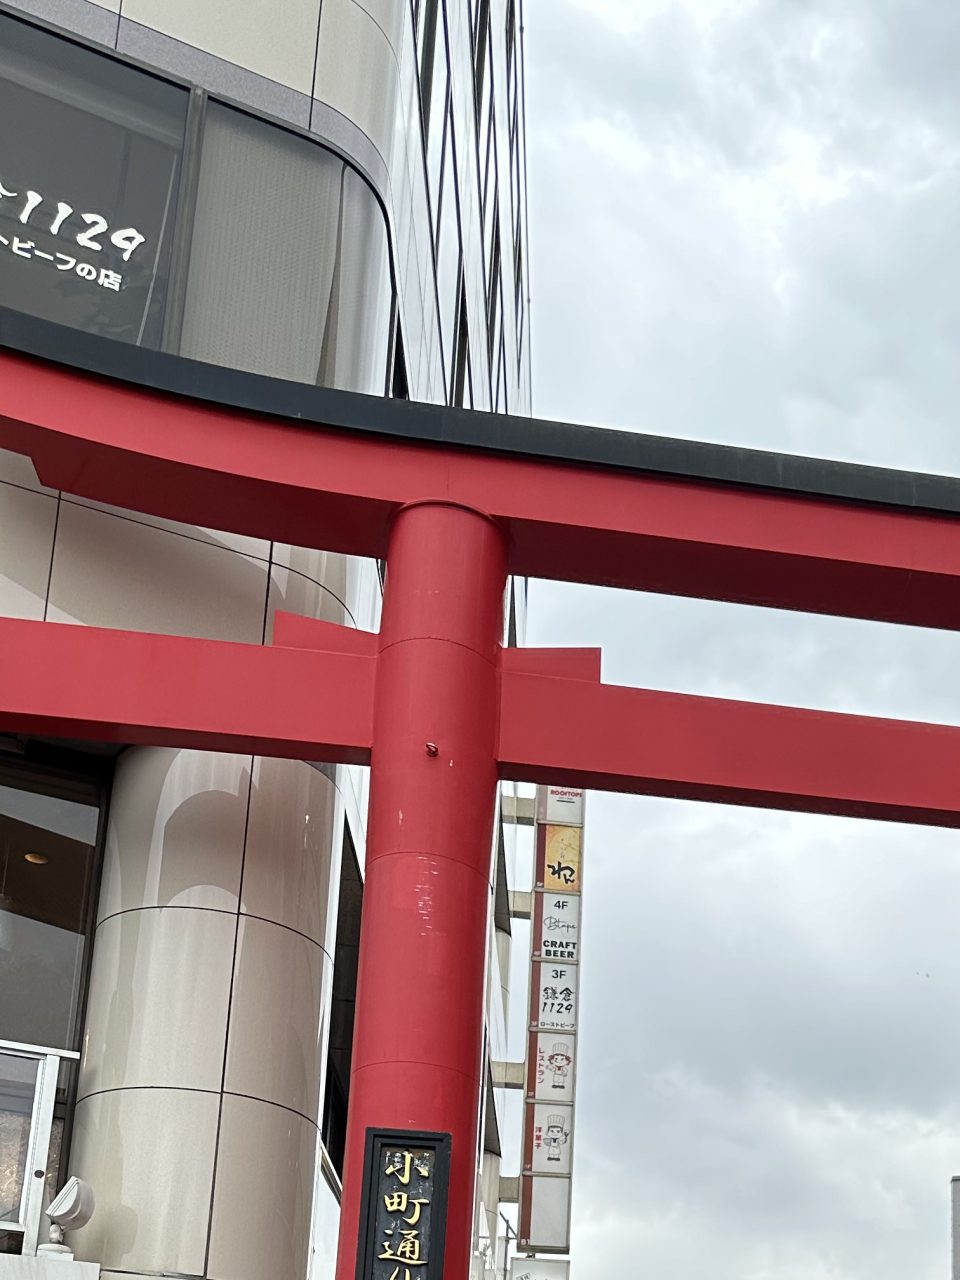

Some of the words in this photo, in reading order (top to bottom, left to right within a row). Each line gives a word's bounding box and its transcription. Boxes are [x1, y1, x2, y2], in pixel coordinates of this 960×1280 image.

[0, 182, 145, 261] 1129
[547, 861, 575, 884] わん
[553, 900, 569, 910] 4F
[543, 939, 577, 950] CRAFT
[545, 949, 575, 959] BEER
[551, 969, 567, 979] 3F
[542, 986, 574, 1001] 鎌倉
[541, 1001, 573, 1015] 1129
[540, 1021, 575, 1029] ローストビーフ
[537, 1047, 545, 1084] レストラン
